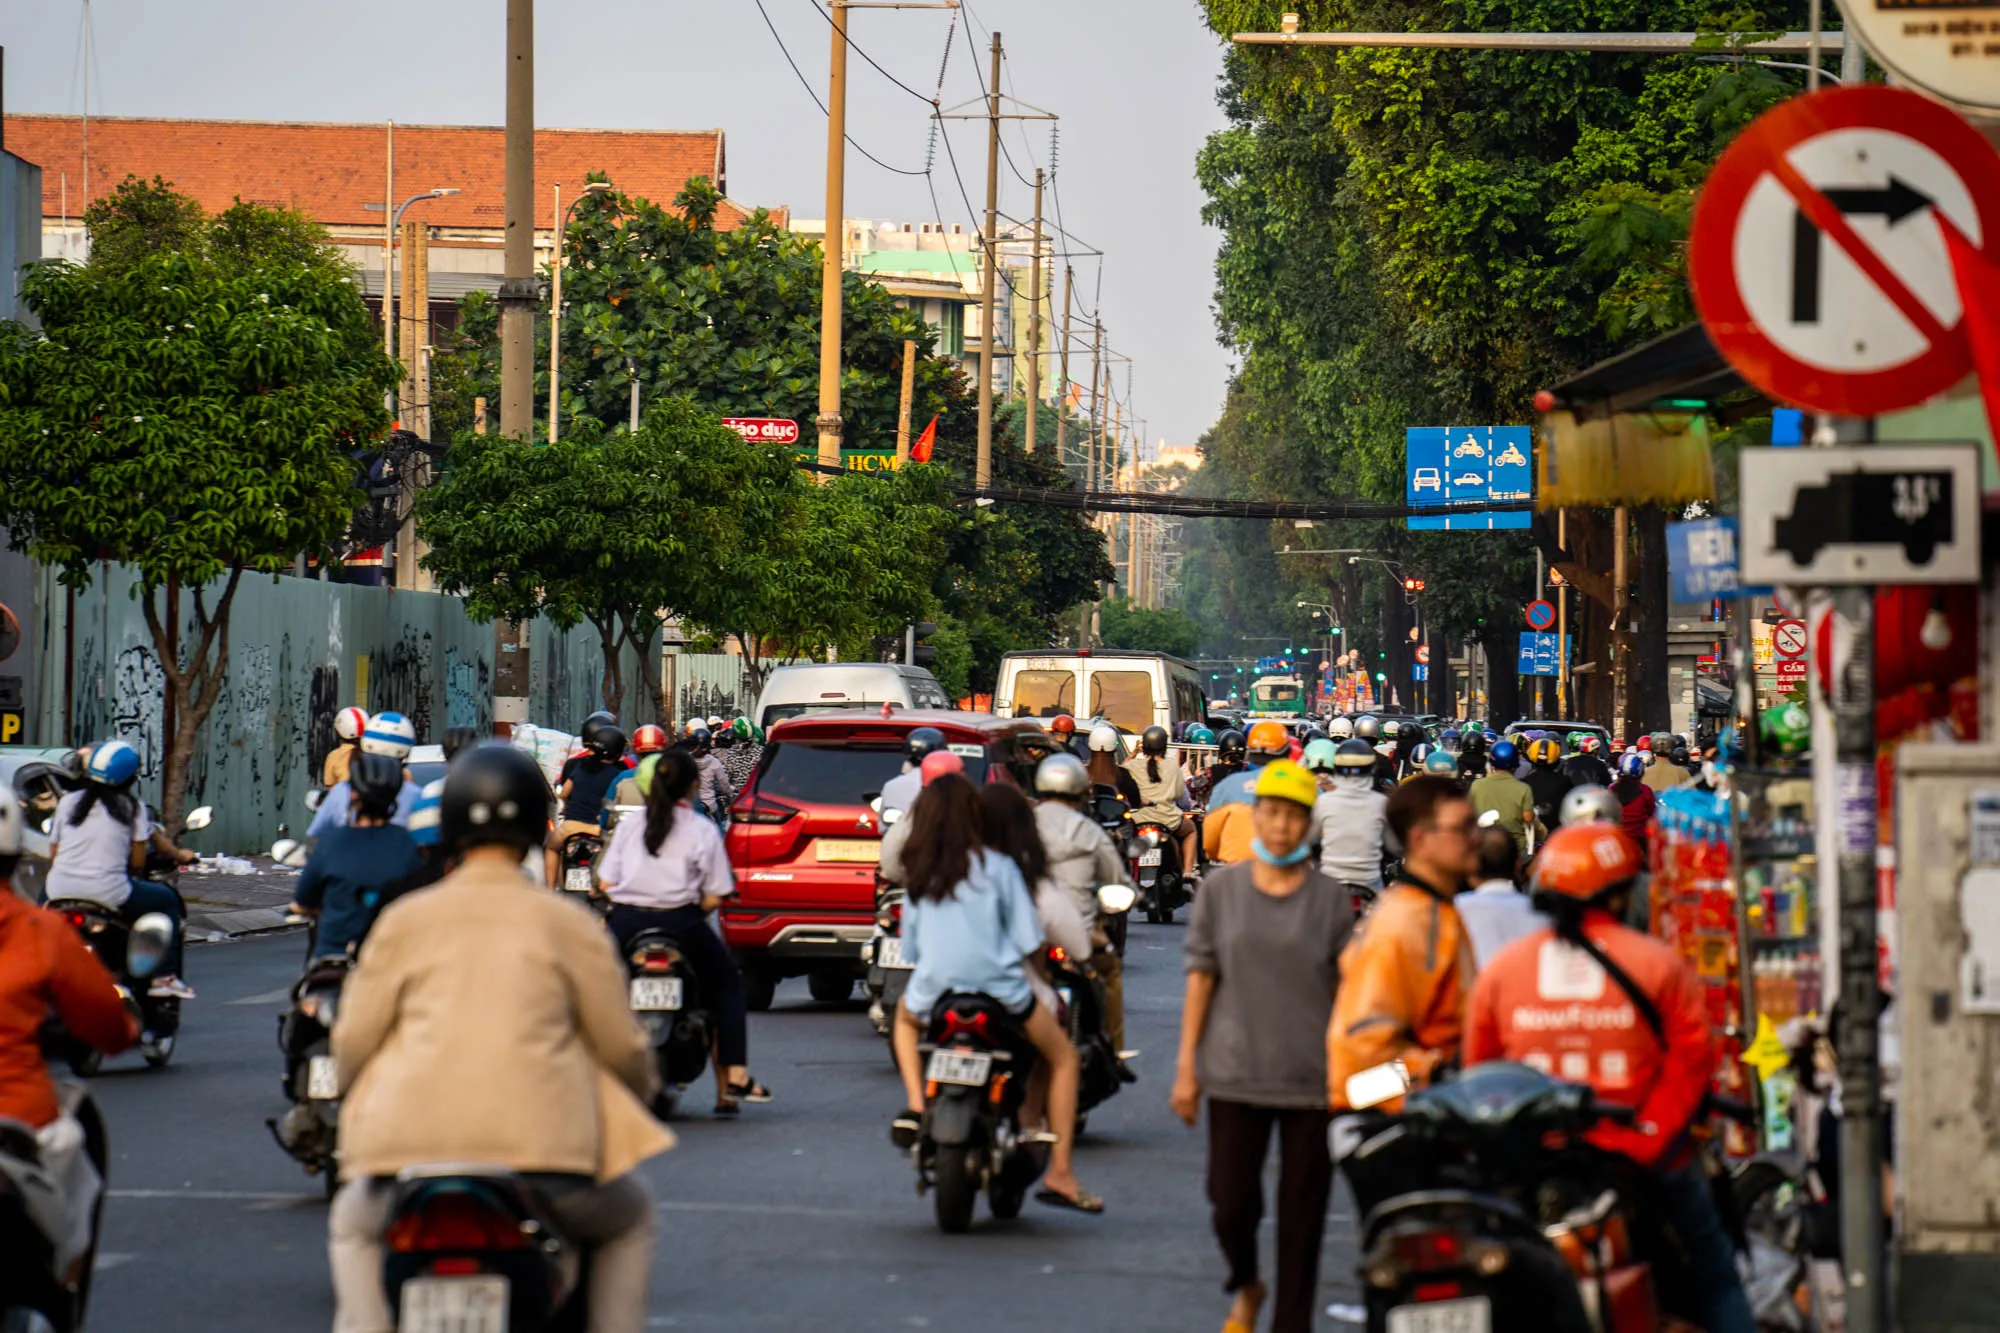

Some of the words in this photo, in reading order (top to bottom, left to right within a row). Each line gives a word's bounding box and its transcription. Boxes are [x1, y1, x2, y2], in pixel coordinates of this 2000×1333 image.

[761, 422, 795, 439] dục
[848, 454, 898, 472] HCM
[2, 712, 21, 744] P
